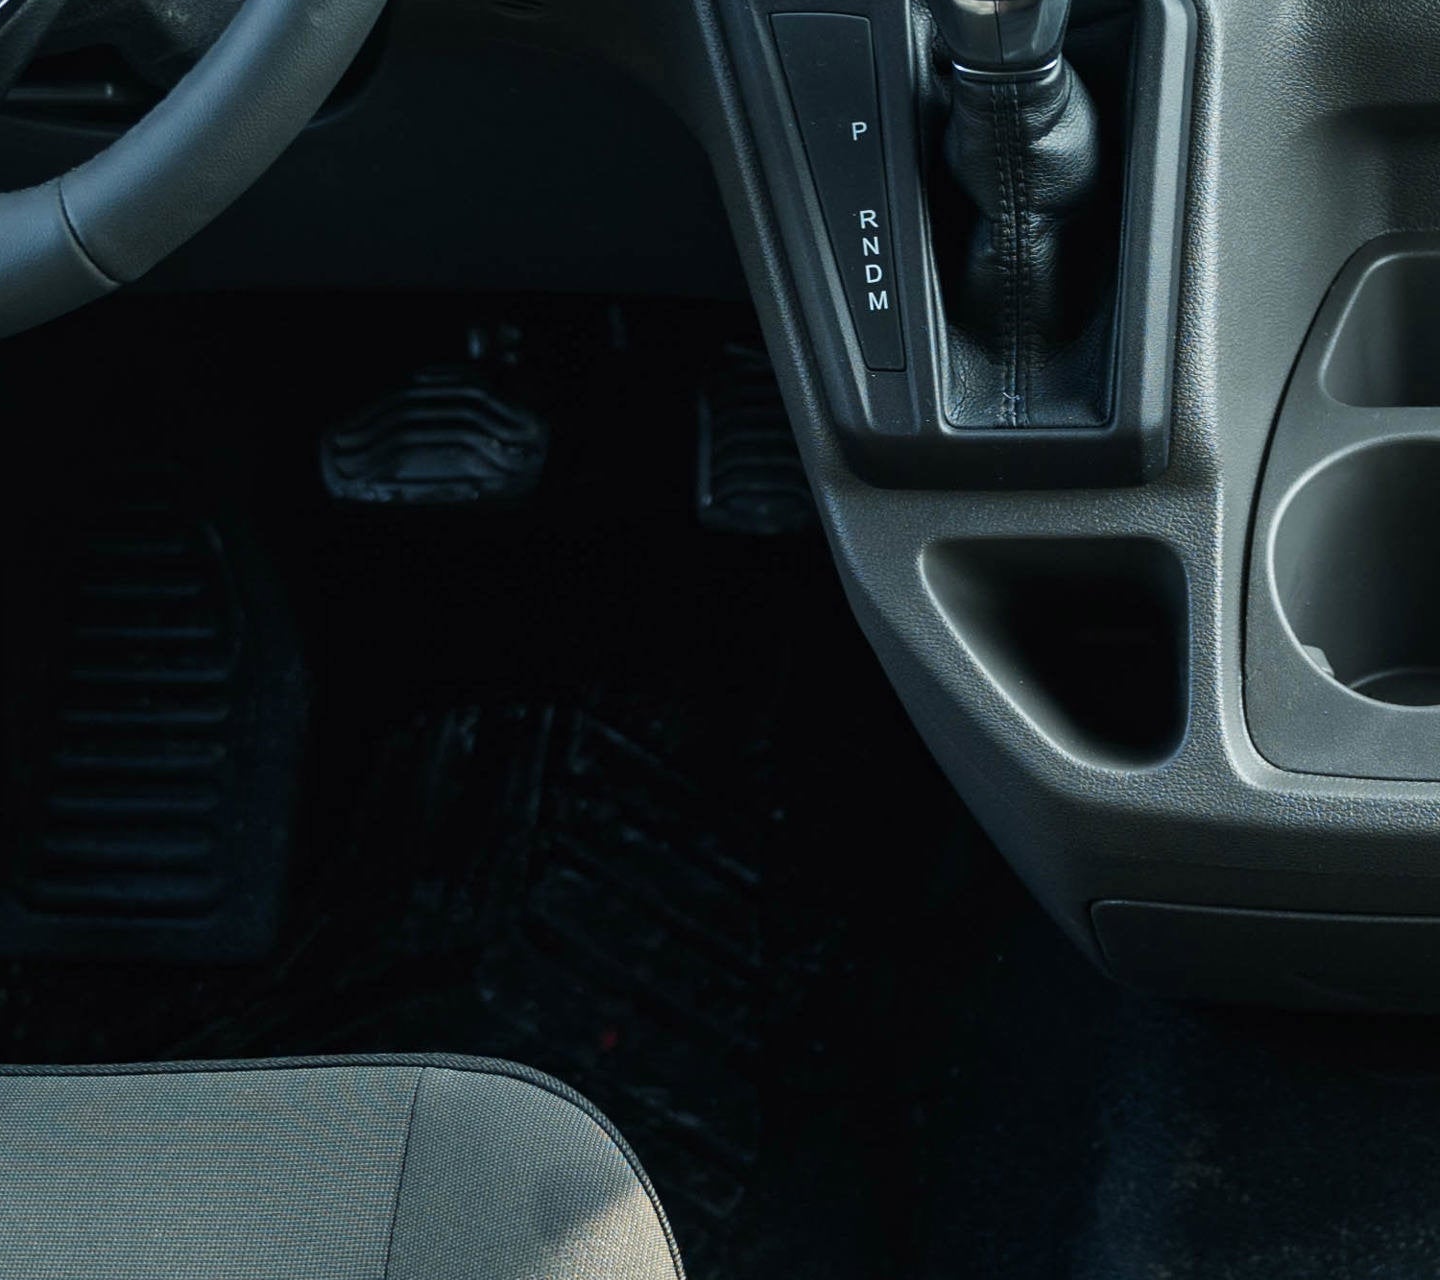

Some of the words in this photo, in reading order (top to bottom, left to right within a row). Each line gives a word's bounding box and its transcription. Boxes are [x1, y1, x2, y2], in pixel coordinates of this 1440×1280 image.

[851, 121, 868, 141] P
[859, 209, 879, 229] R
[862, 236, 880, 256] N
[865, 264, 883, 283] D
[868, 290, 889, 311] M
